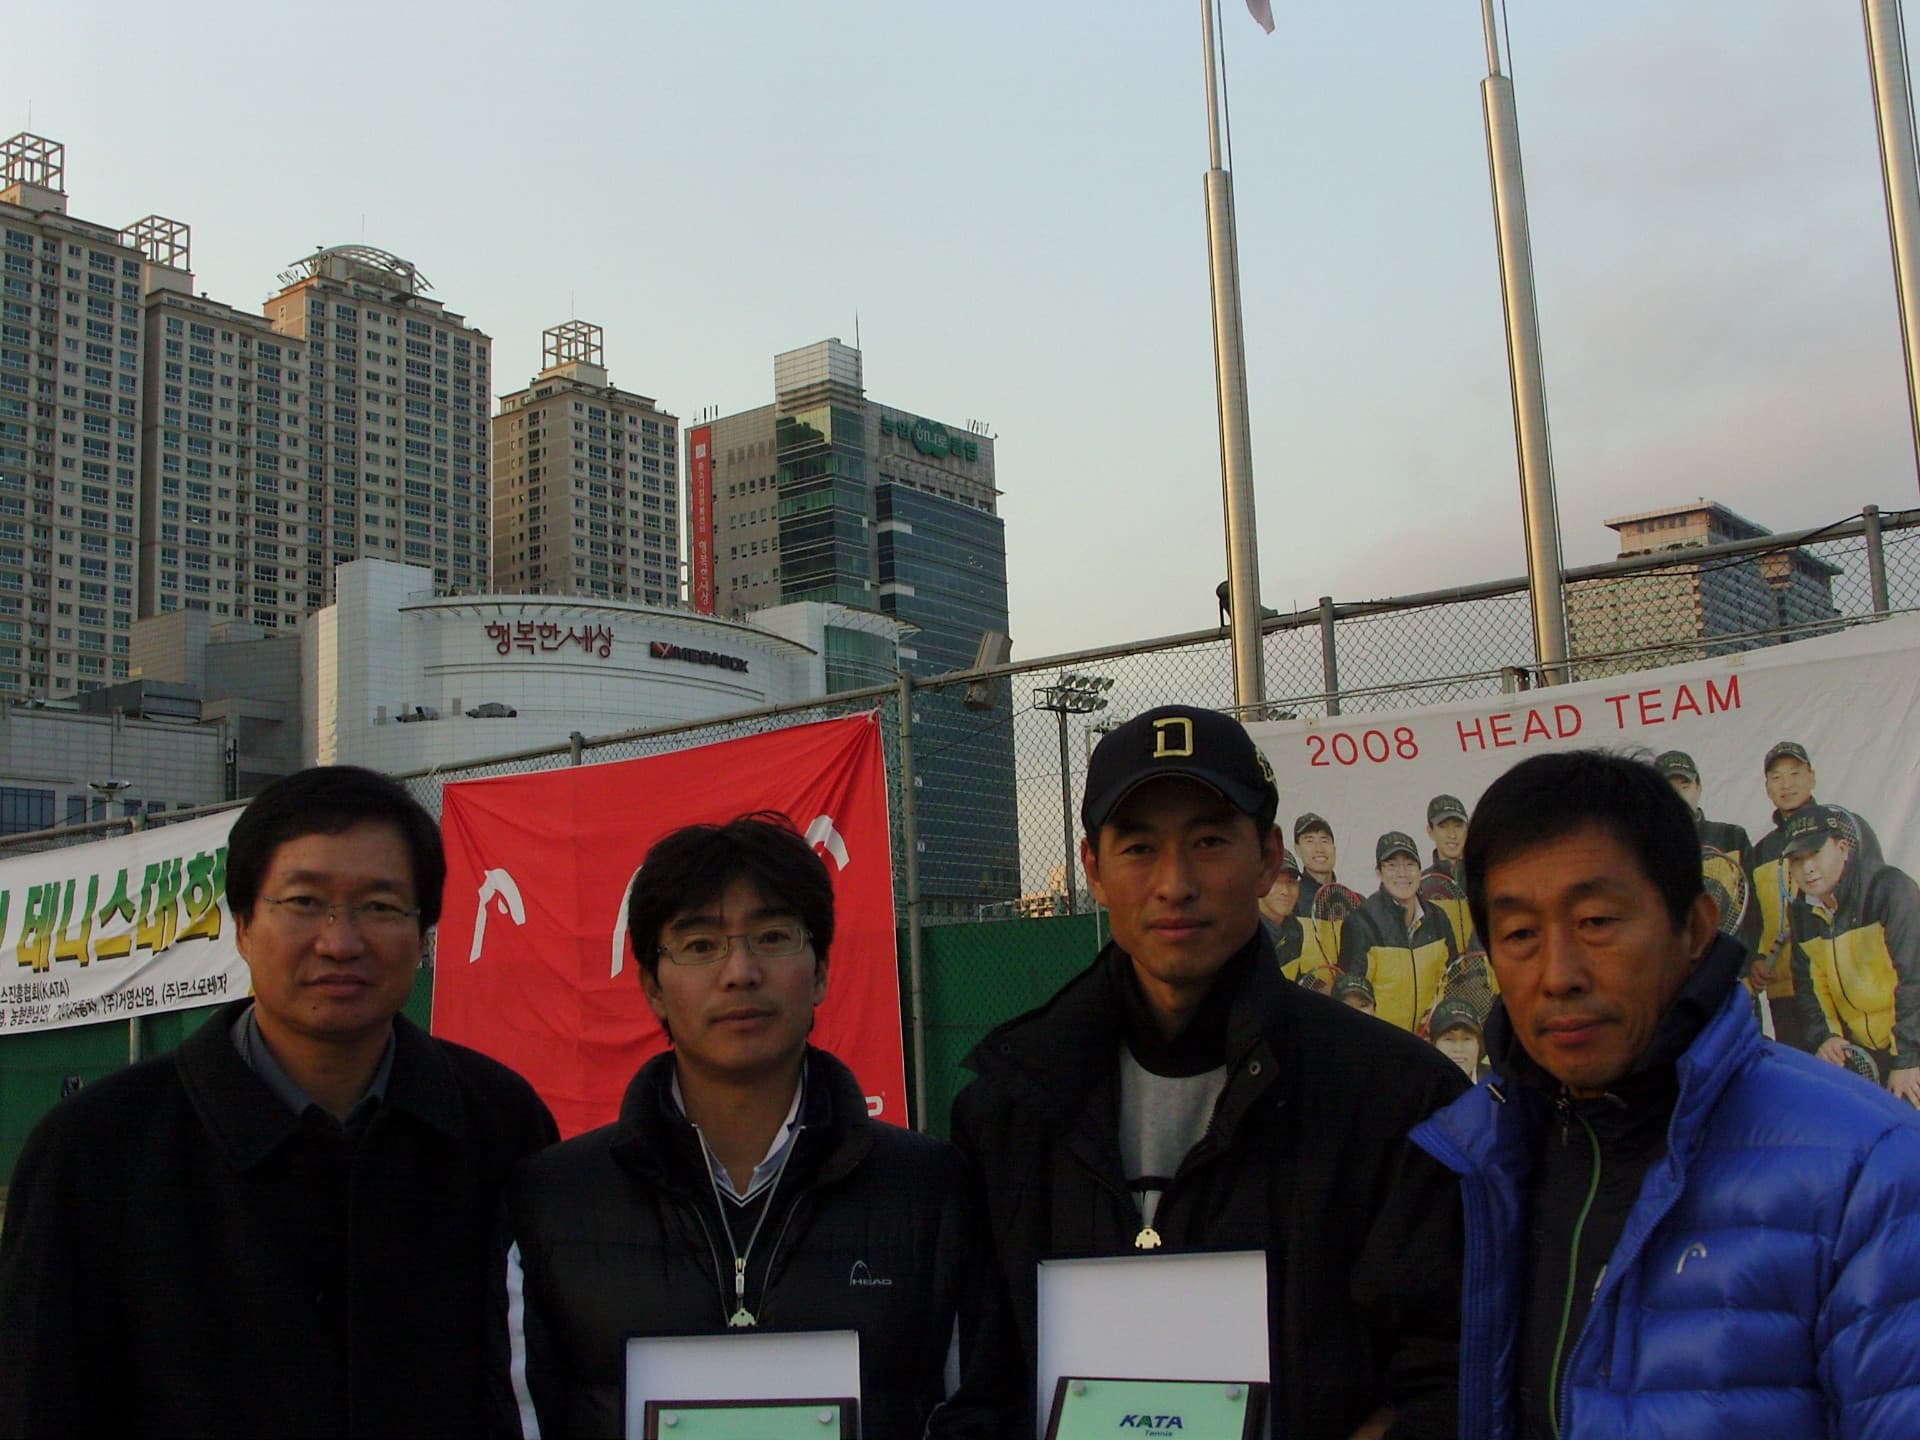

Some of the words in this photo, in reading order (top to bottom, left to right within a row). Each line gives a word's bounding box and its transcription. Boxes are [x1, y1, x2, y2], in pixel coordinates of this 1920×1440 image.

[484, 620, 614, 658] 행복한세상
[673, 646, 749, 673] MEGABOX
[1153, 717, 1194, 758] D
[1306, 726, 1420, 767] 2008
[1456, 703, 1583, 753] HEAD
[1604, 674, 1742, 730] TEAM
[1119, 1414, 1183, 1429] KATA
